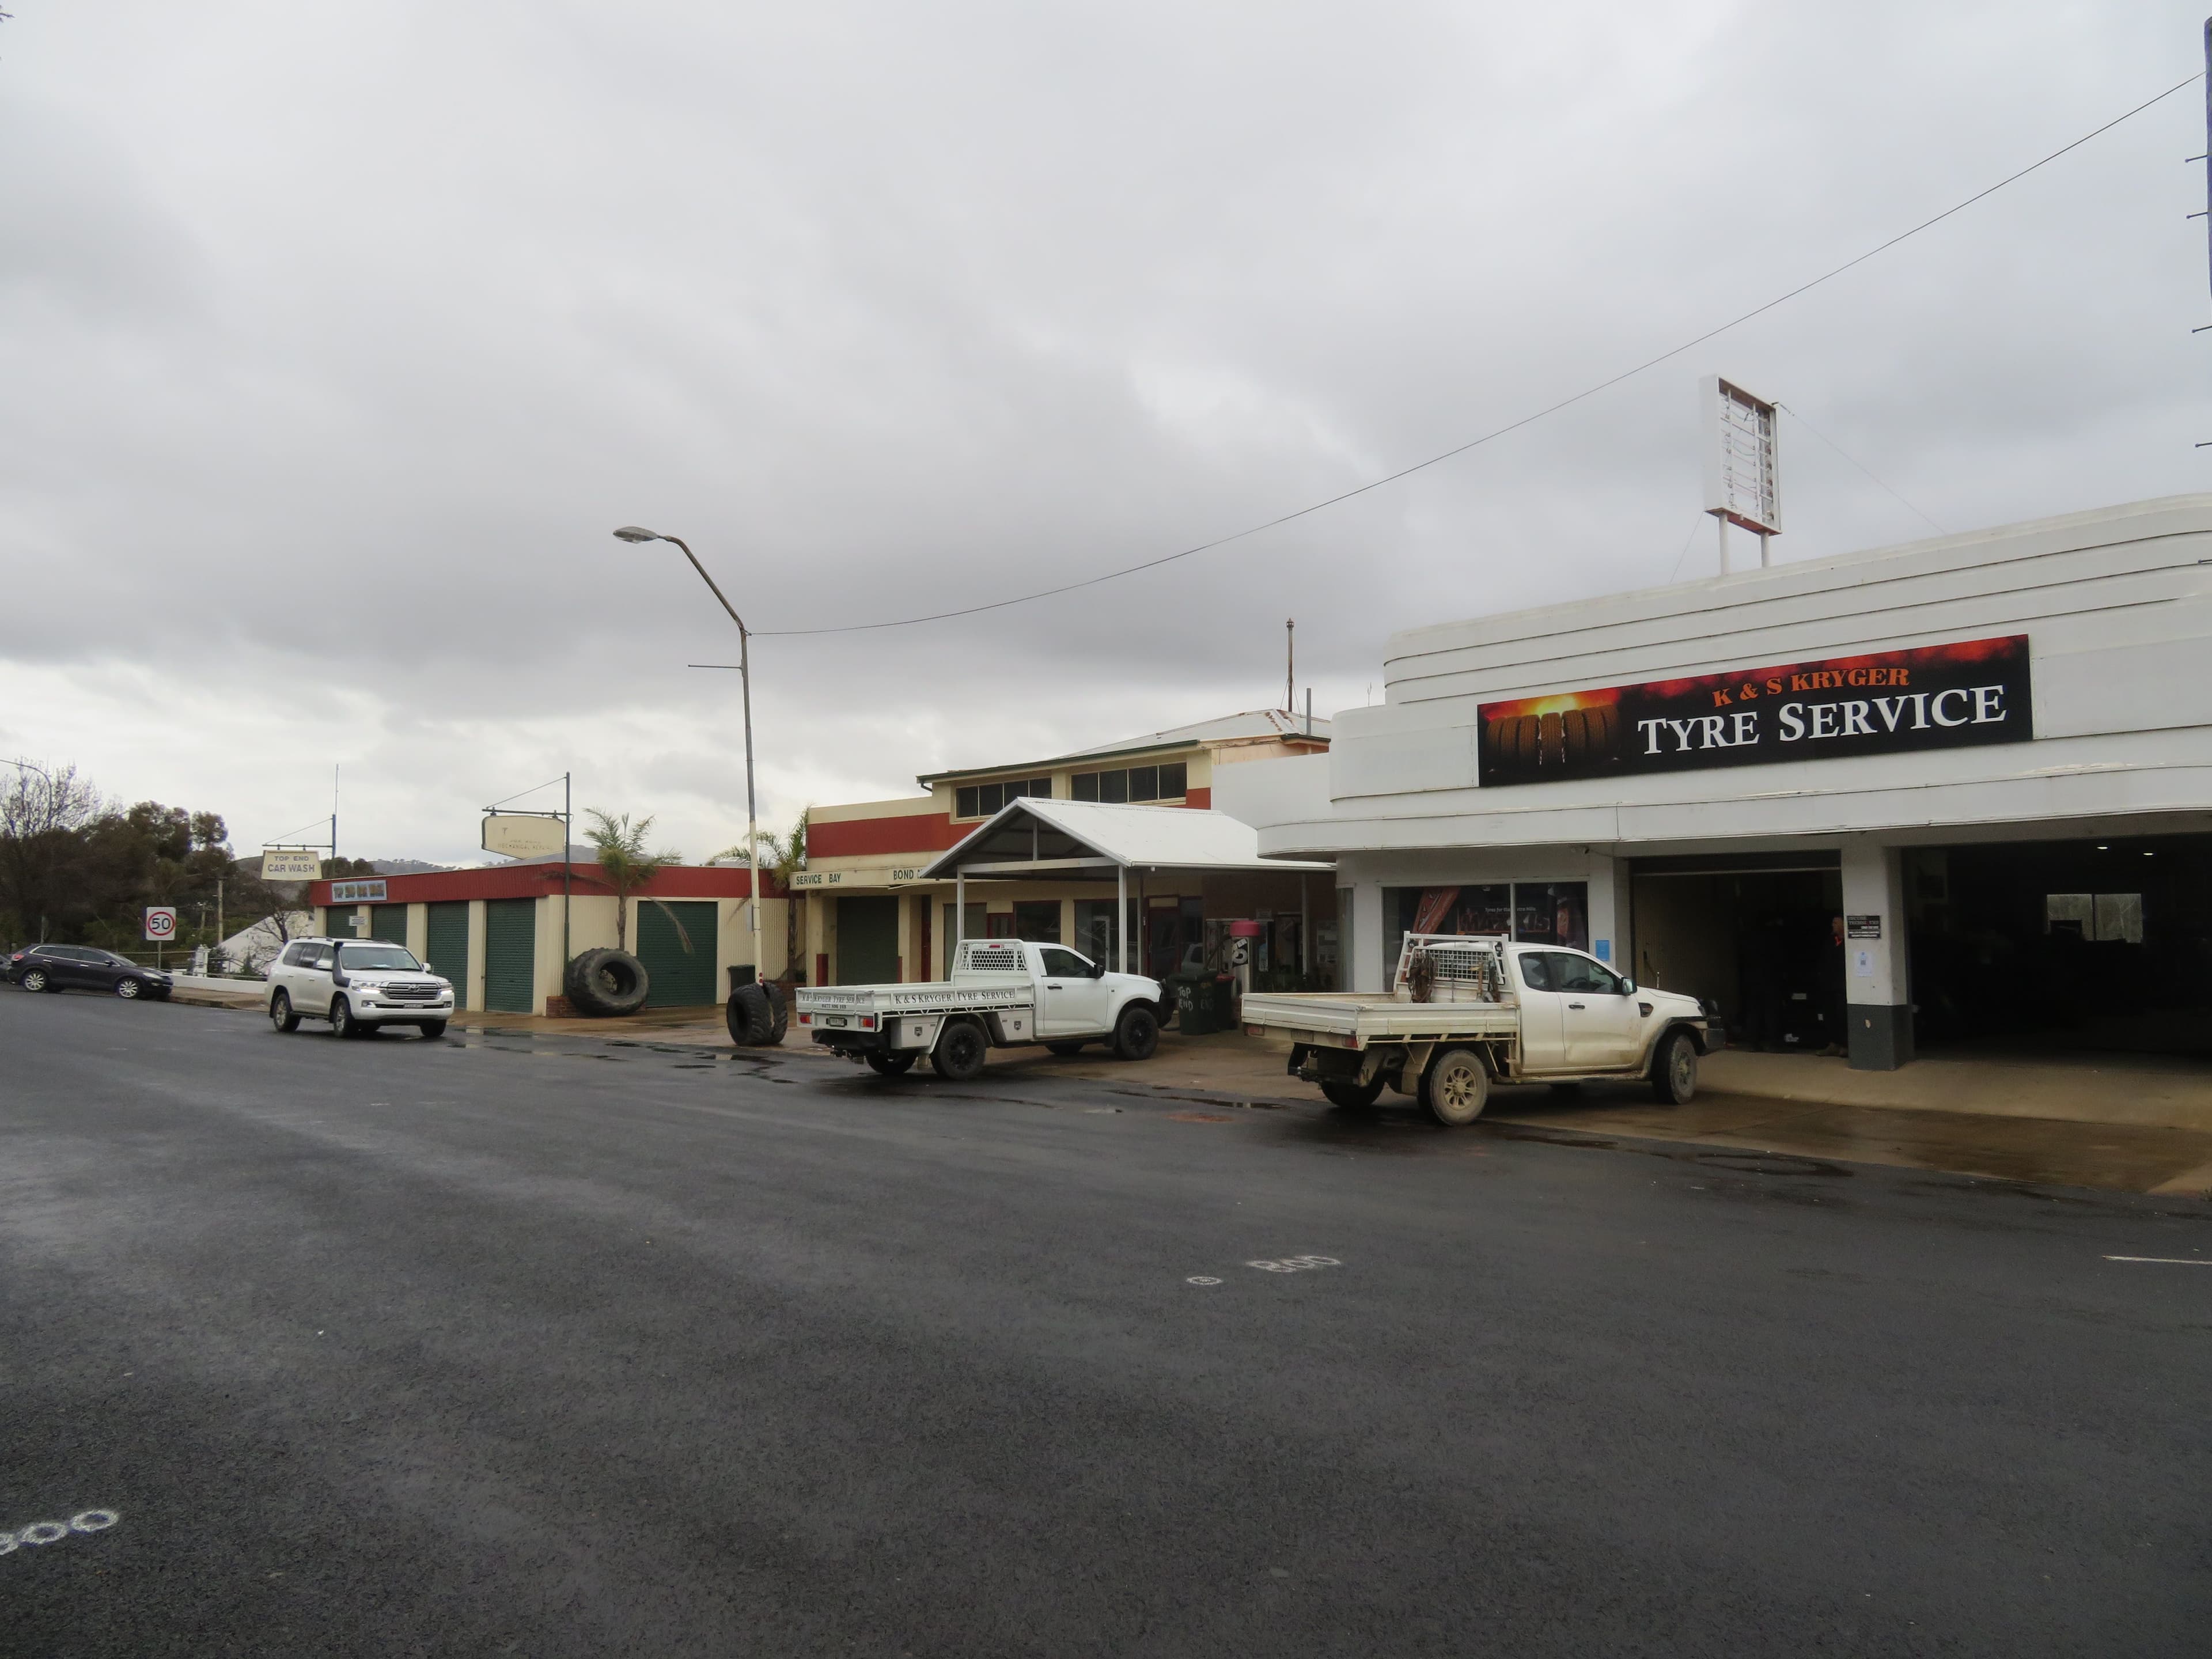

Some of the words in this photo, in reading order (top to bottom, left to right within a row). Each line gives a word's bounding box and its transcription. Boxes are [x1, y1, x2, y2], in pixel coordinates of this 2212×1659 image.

[1711, 688, 1733, 707] K
[1740, 683, 1759, 700] &
[1766, 677, 1783, 695] S
[1790, 668, 1910, 692] KRYGER
[1637, 711, 1760, 755] TYRE
[1778, 684, 2007, 742] SERVICE
[267, 863, 286, 873] CAR
[289, 864, 315, 873] WASH
[796, 874, 822, 885] SERVICE
[828, 873, 842, 883] BAY
[893, 869, 914, 880] BOND
[152, 918, 171, 929] 50
[895, 995, 902, 1004] K
[903, 995, 910, 1004] &
[912, 994, 916, 1003] S
[918, 994, 952, 1003] KRYGER
[957, 992, 978, 1001] TYRE
[981, 990, 1015, 1000] SERVICE
[1179, 998, 1194, 1012] END
